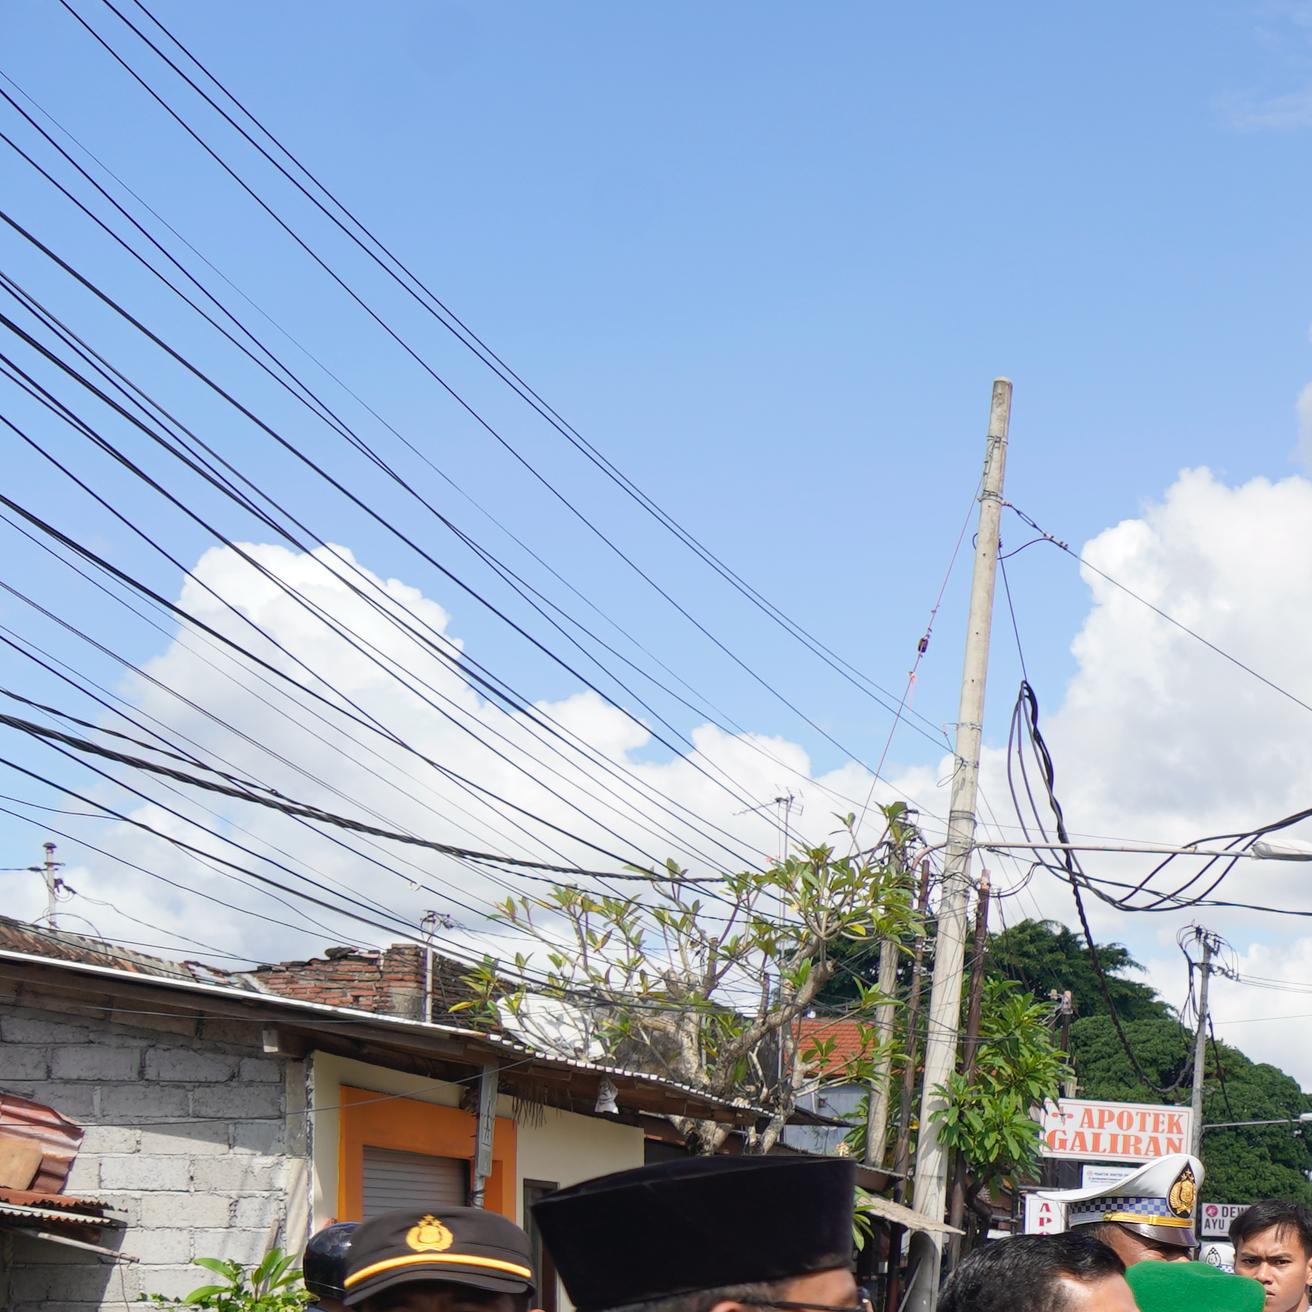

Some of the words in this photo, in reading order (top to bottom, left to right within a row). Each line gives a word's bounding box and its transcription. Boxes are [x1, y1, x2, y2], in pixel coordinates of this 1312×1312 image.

[1080, 1108, 1184, 1134] APOTEK
[1047, 1129, 1183, 1157] GALIRAN
[1204, 1218, 1225, 1230] AYU
